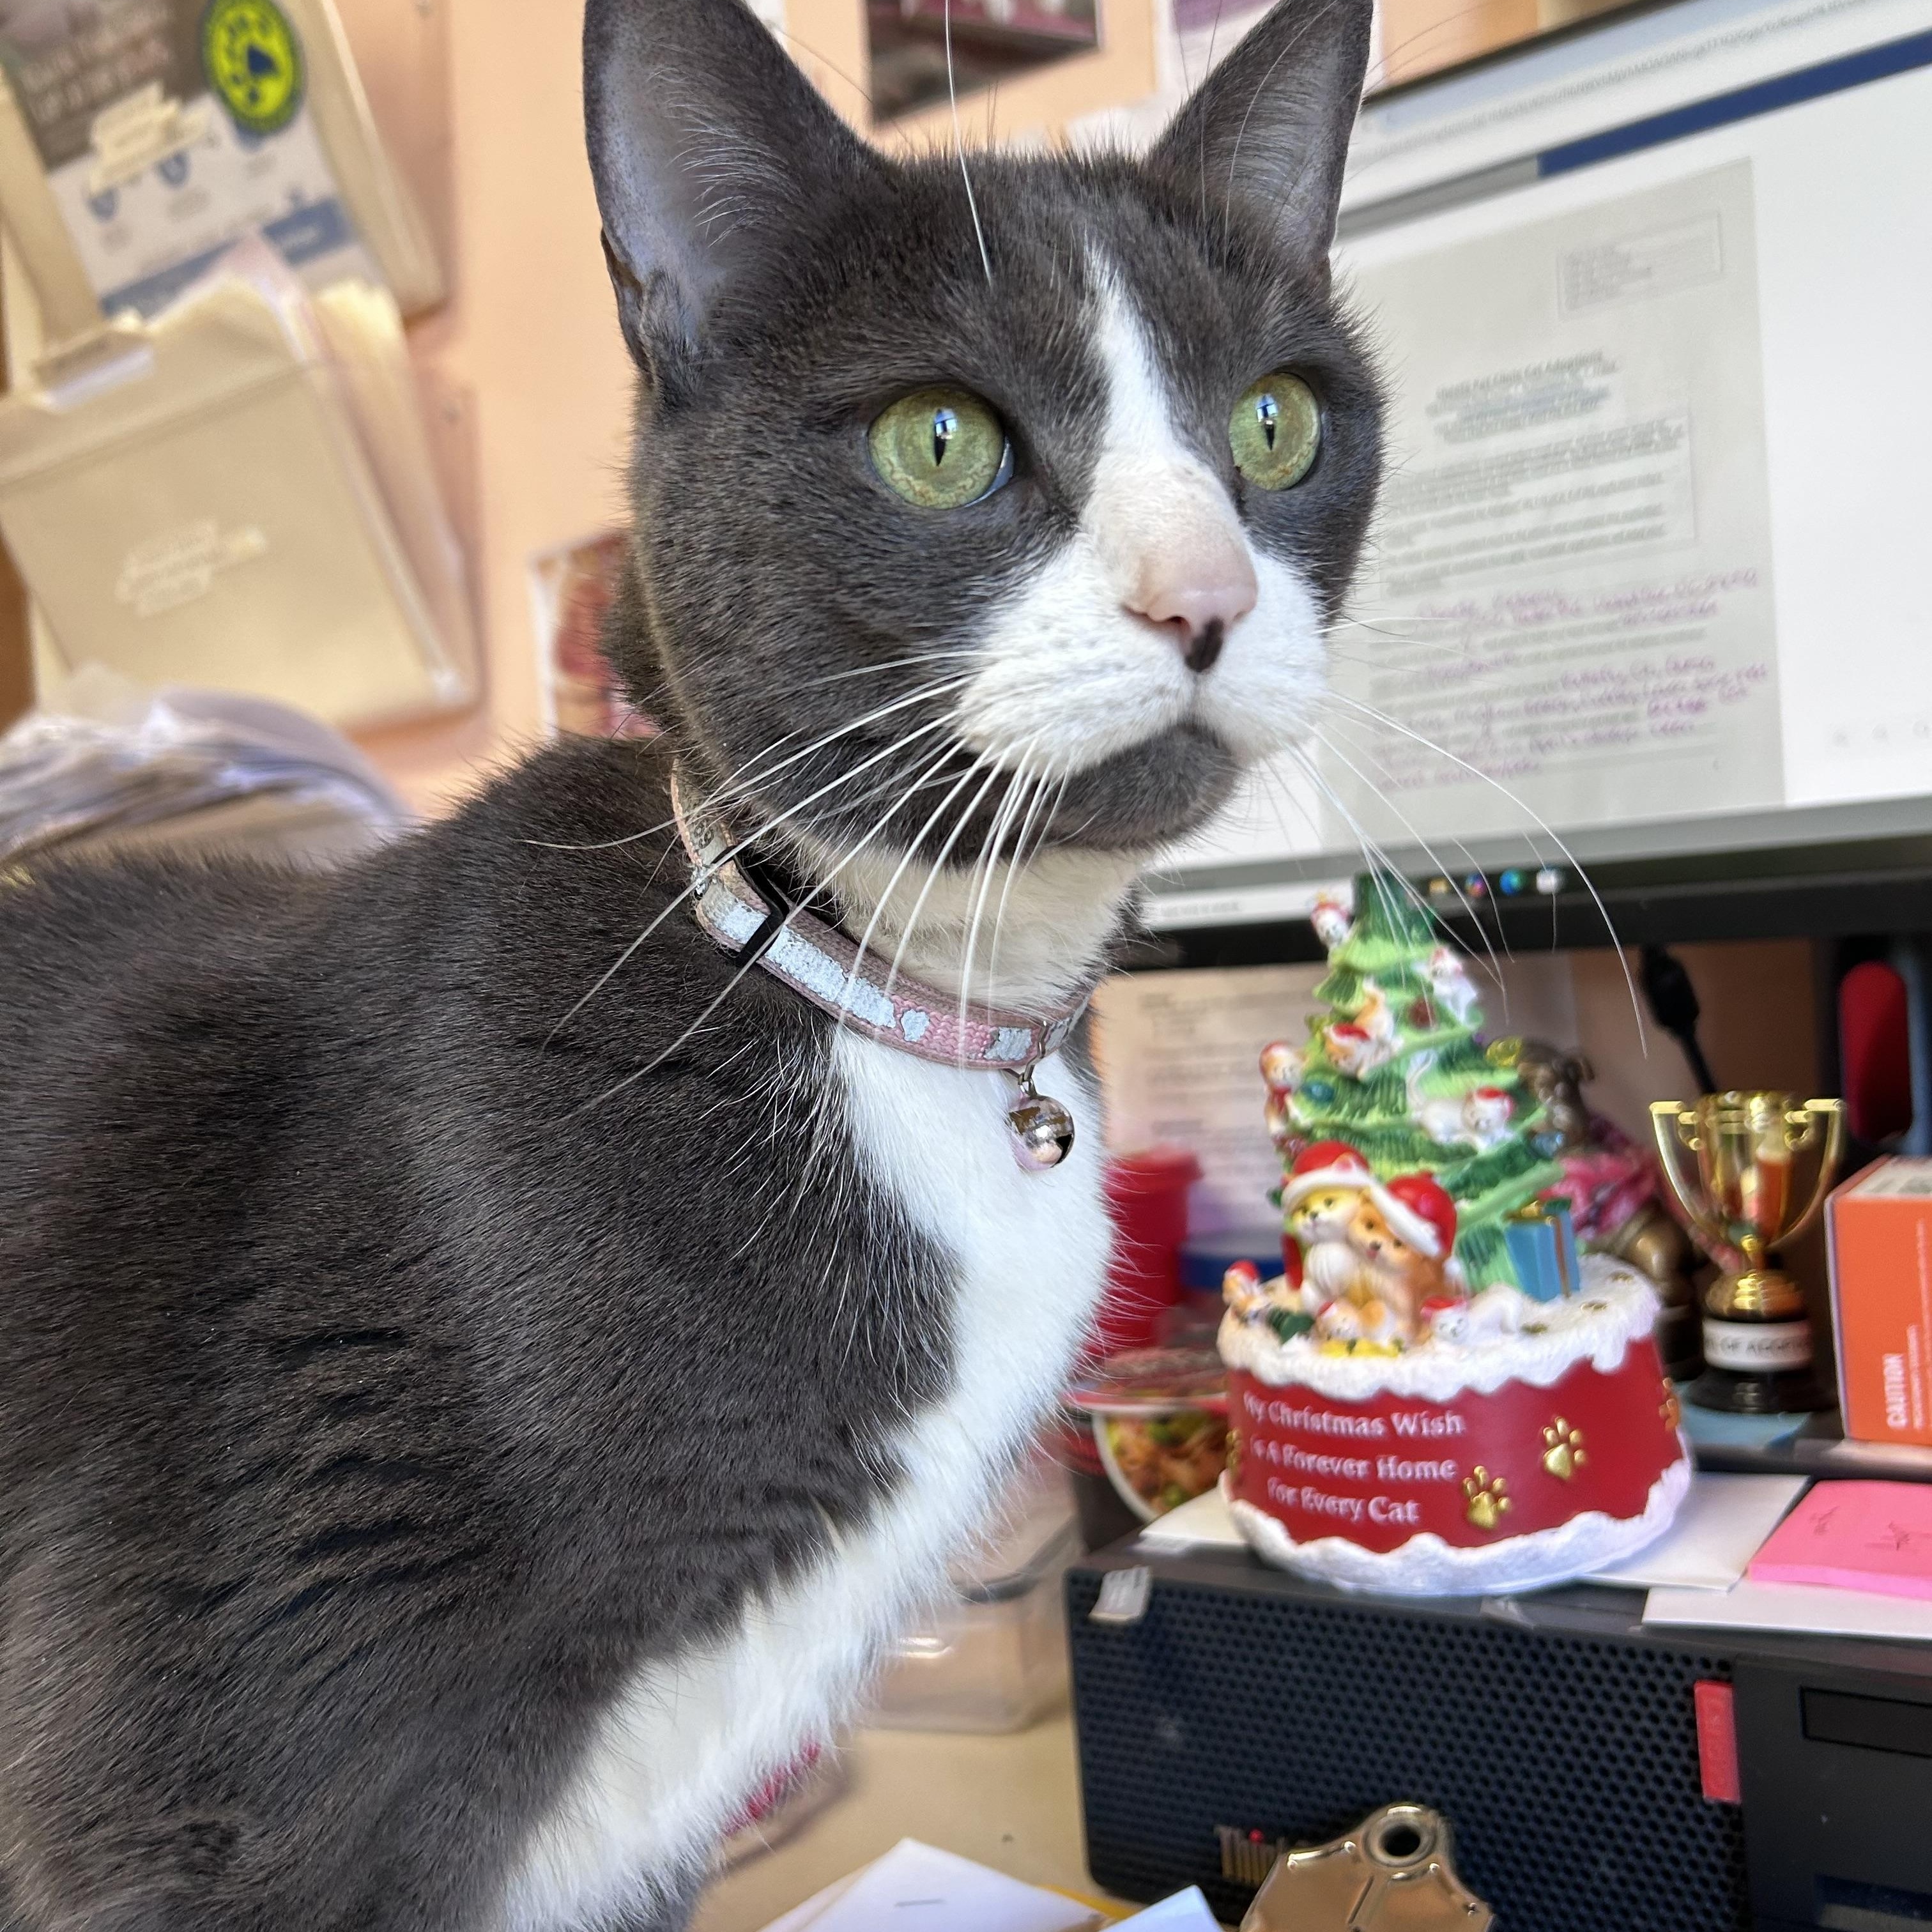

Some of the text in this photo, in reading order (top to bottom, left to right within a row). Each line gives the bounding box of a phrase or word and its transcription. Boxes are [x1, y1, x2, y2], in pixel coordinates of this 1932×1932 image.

[1882, 1353, 1907, 1429] CAUTION
[1268, 1400, 1386, 1437] Christmas
[1391, 1409, 1465, 1437] Wish
[1282, 1444, 1370, 1480] Forever
[1376, 1455, 1457, 1480] Home
[1268, 1477, 1421, 1524] For Every Cat
